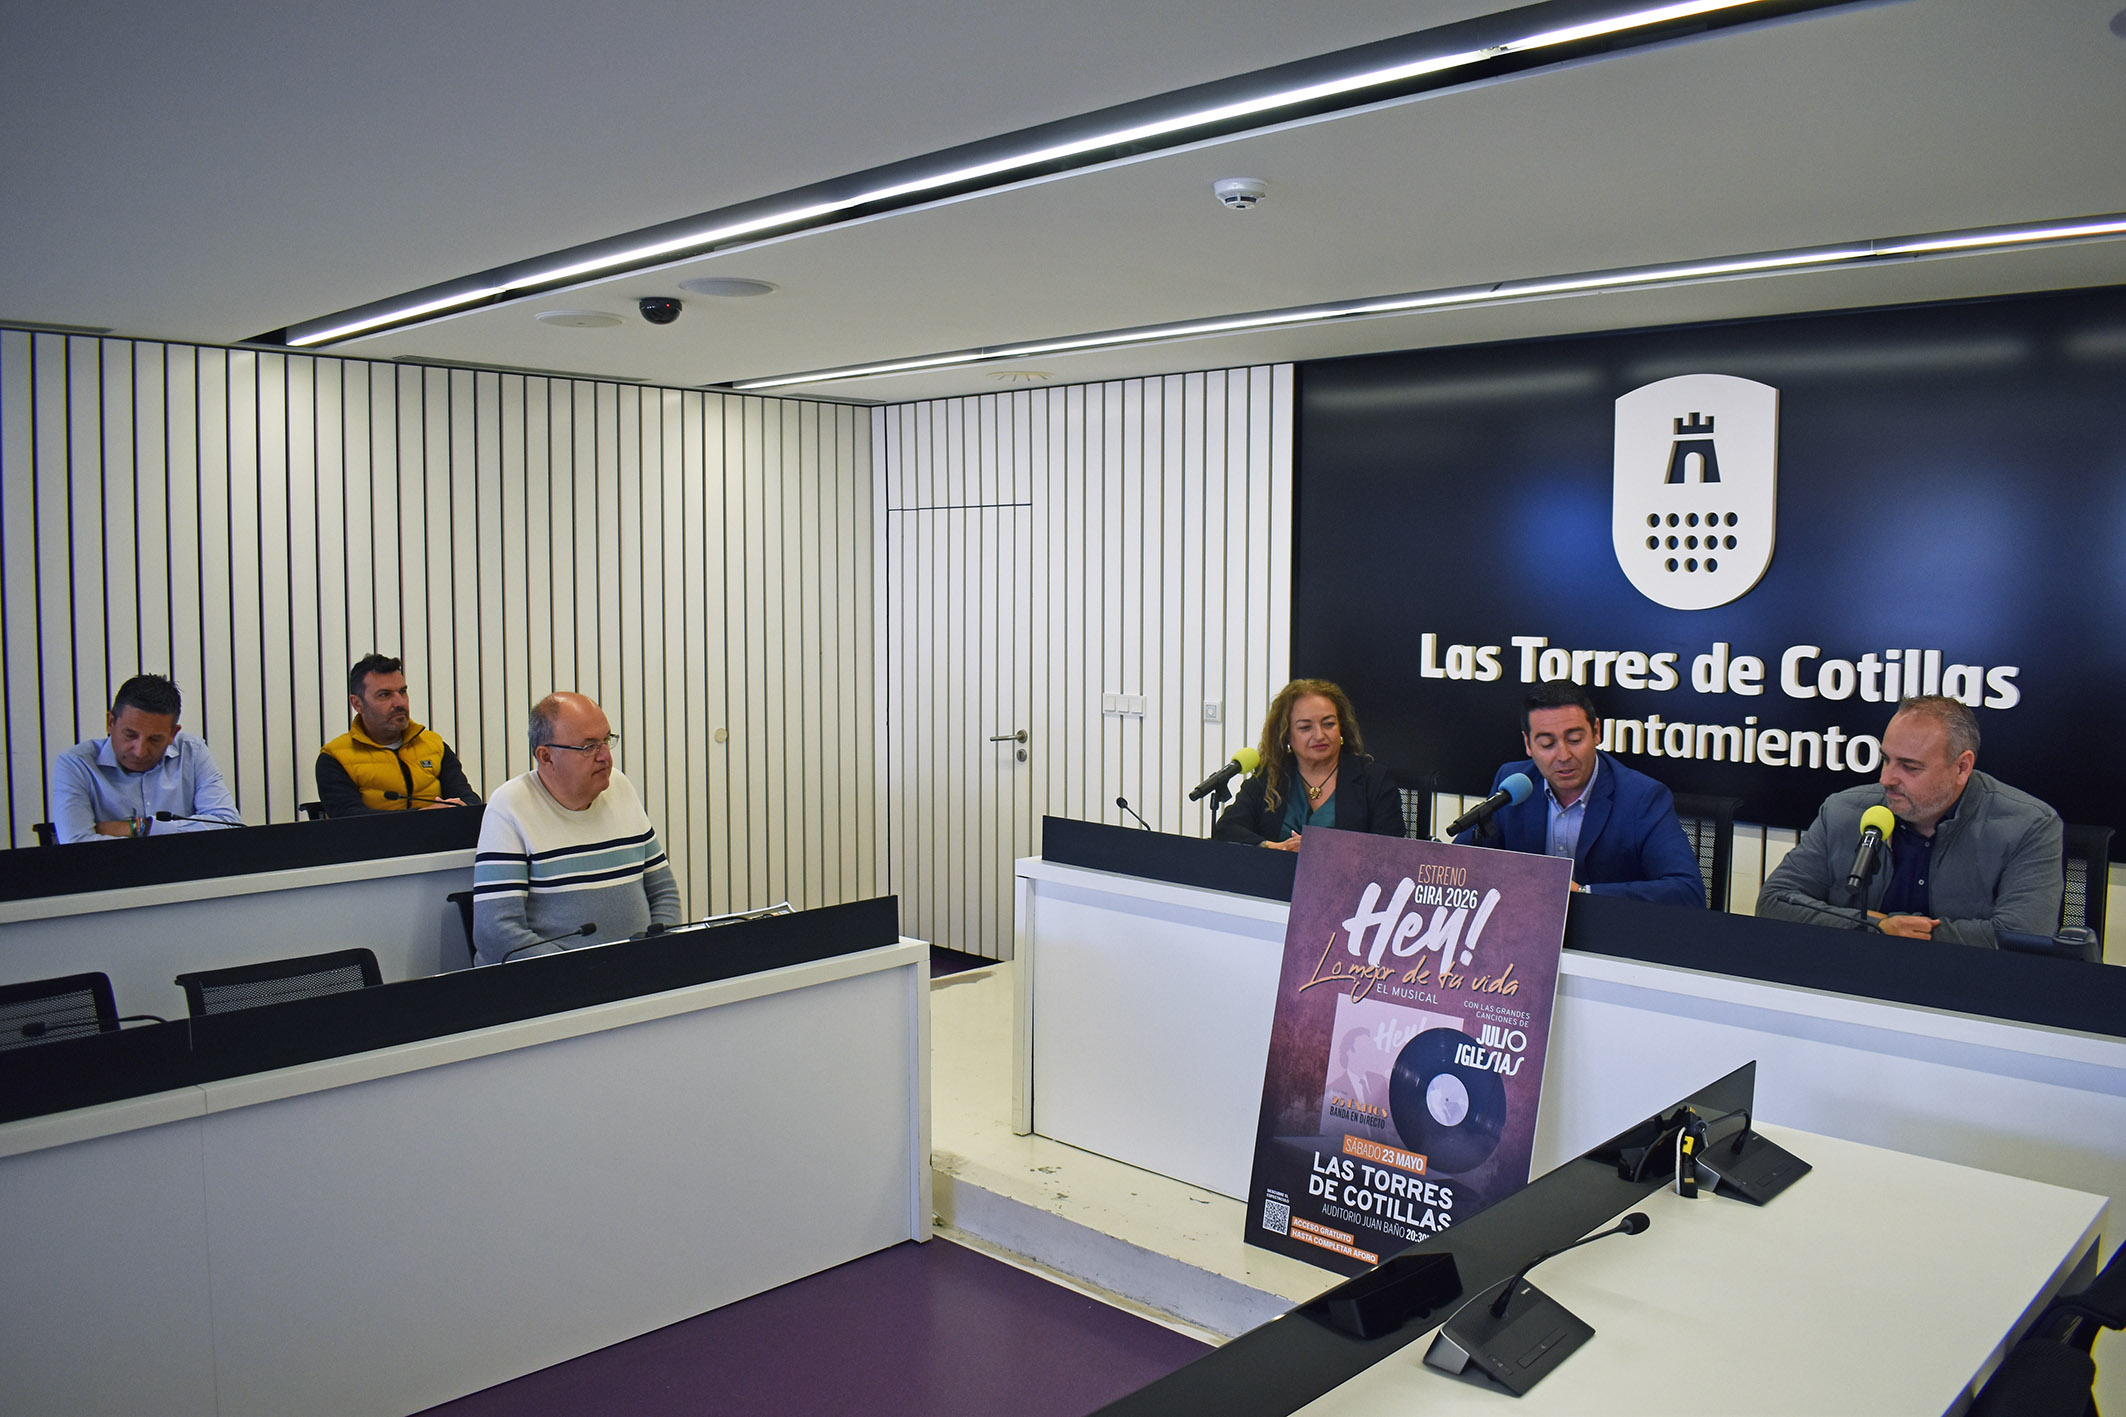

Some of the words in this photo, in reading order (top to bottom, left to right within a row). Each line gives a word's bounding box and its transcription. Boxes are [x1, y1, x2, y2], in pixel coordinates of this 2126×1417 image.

[1420, 633, 1502, 682] Las
[1511, 636, 1679, 691] Torres
[1692, 642, 1765, 695] de
[1780, 645, 2020, 710] Cotillas
[1595, 714, 1882, 773] untamiento
[1418, 864, 1467, 887] ESTRENO
[1414, 884, 1442, 907] GIRA
[1444, 887, 1478, 909] 2026
[1341, 876, 1501, 975] Hey!
[1299, 932, 1357, 993] Lo
[1348, 962, 1396, 1003] mejor
[1402, 954, 1431, 985] de
[1438, 960, 1464, 990] tu
[1471, 963, 1520, 996] vida
[1376, 983, 1388, 995] EL
[1391, 986, 1439, 1005] MUSICAL
[1463, 1000, 1479, 1009] CON
[1480, 1004, 1494, 1012] LAS
[1496, 1006, 1531, 1020] GRANDES
[1475, 1011, 1518, 1026] CANCIONES
[1519, 1020, 1529, 1028] DE
[1475, 1023, 1527, 1053] JULIO
[1454, 1043, 1525, 1076] IGLESIAS
[1329, 1105, 1350, 1121] BANDA
[1350, 1111, 1359, 1123] EN
[1360, 1113, 1386, 1130] DIRECTO
[1345, 1137, 1381, 1160] SÁBADO
[1382, 1148, 1395, 1164] 23
[1396, 1152, 1424, 1172] MAYO
[1313, 1151, 1354, 1181] LAS
[1361, 1164, 1453, 1209] TORRES
[1308, 1174, 1338, 1201] DE
[1343, 1185, 1452, 1232] COTILLAS
[1293, 1218, 1319, 1232] ACCESO
[1320, 1227, 1352, 1242] GRATUITO
[1322, 1203, 1361, 1225] AUDITORIO
[1362, 1215, 1382, 1232] JUAN
[1383, 1221, 1406, 1239] BAÑO
[1292, 1230, 1313, 1242] HASTA
[1313, 1236, 1352, 1255] COMPLETAR
[1353, 1249, 1376, 1263] AFORO
